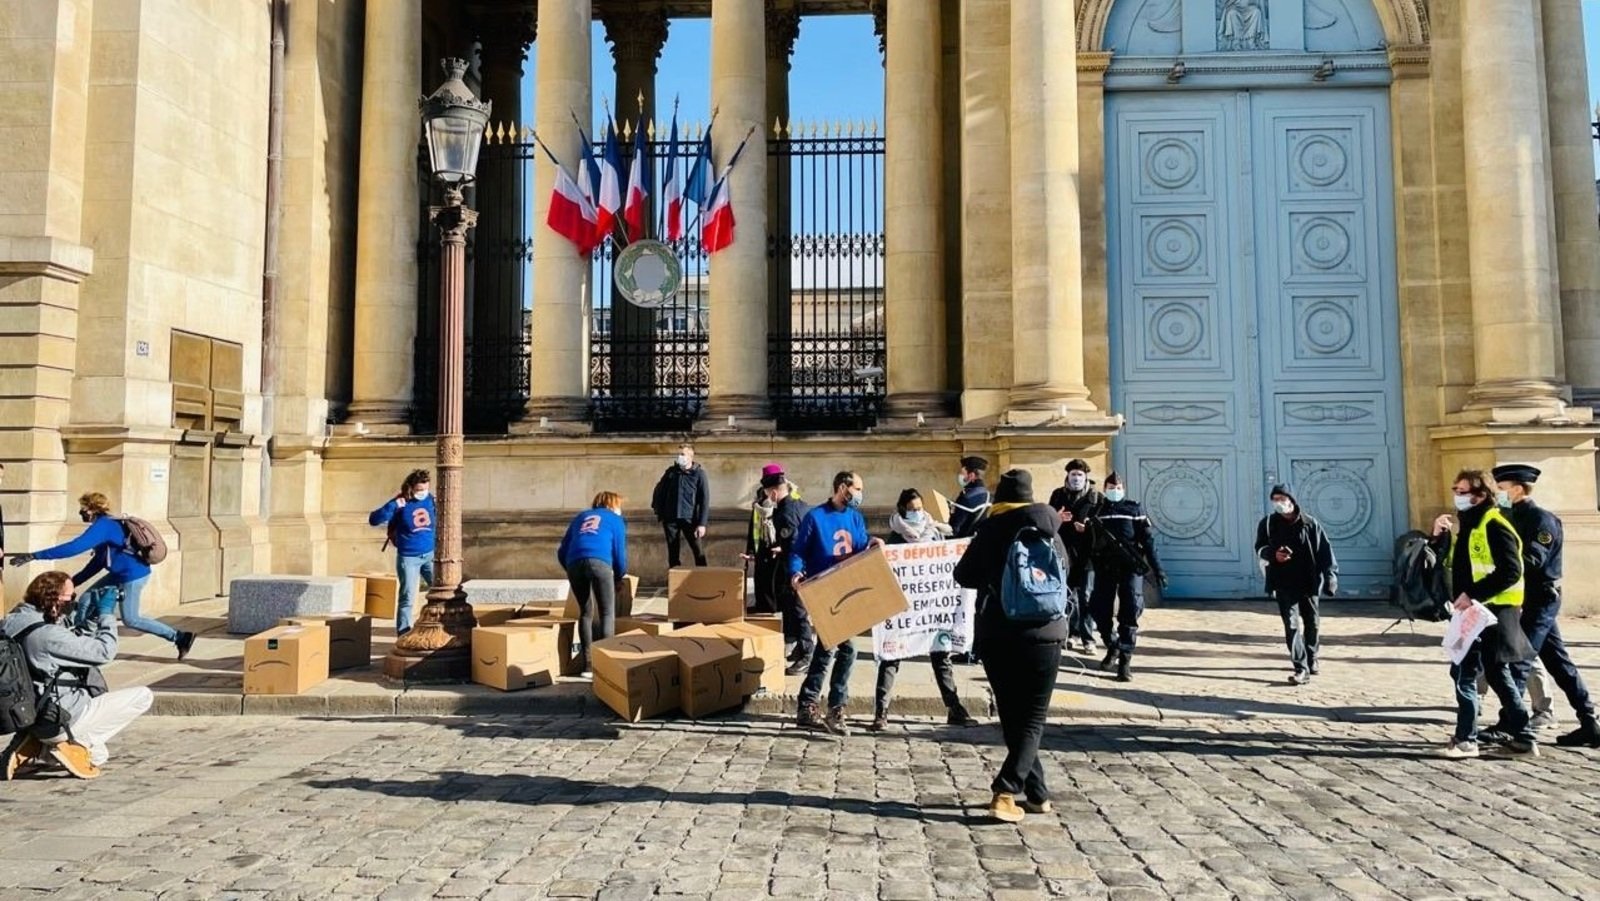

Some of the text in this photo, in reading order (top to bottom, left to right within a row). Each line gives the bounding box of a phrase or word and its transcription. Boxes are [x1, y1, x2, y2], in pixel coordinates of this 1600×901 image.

[412, 507, 431, 527] a
[833, 529, 853, 556] a
[885, 548, 899, 561] ES
[892, 562, 957, 577] NT LE CHO
[901, 579, 959, 594] PRÉSERVE
[913, 595, 962, 611] EMPLOIS
[885, 618, 893, 630] &
[898, 617, 911, 629] LE
[915, 612, 957, 626] CLIMAT
